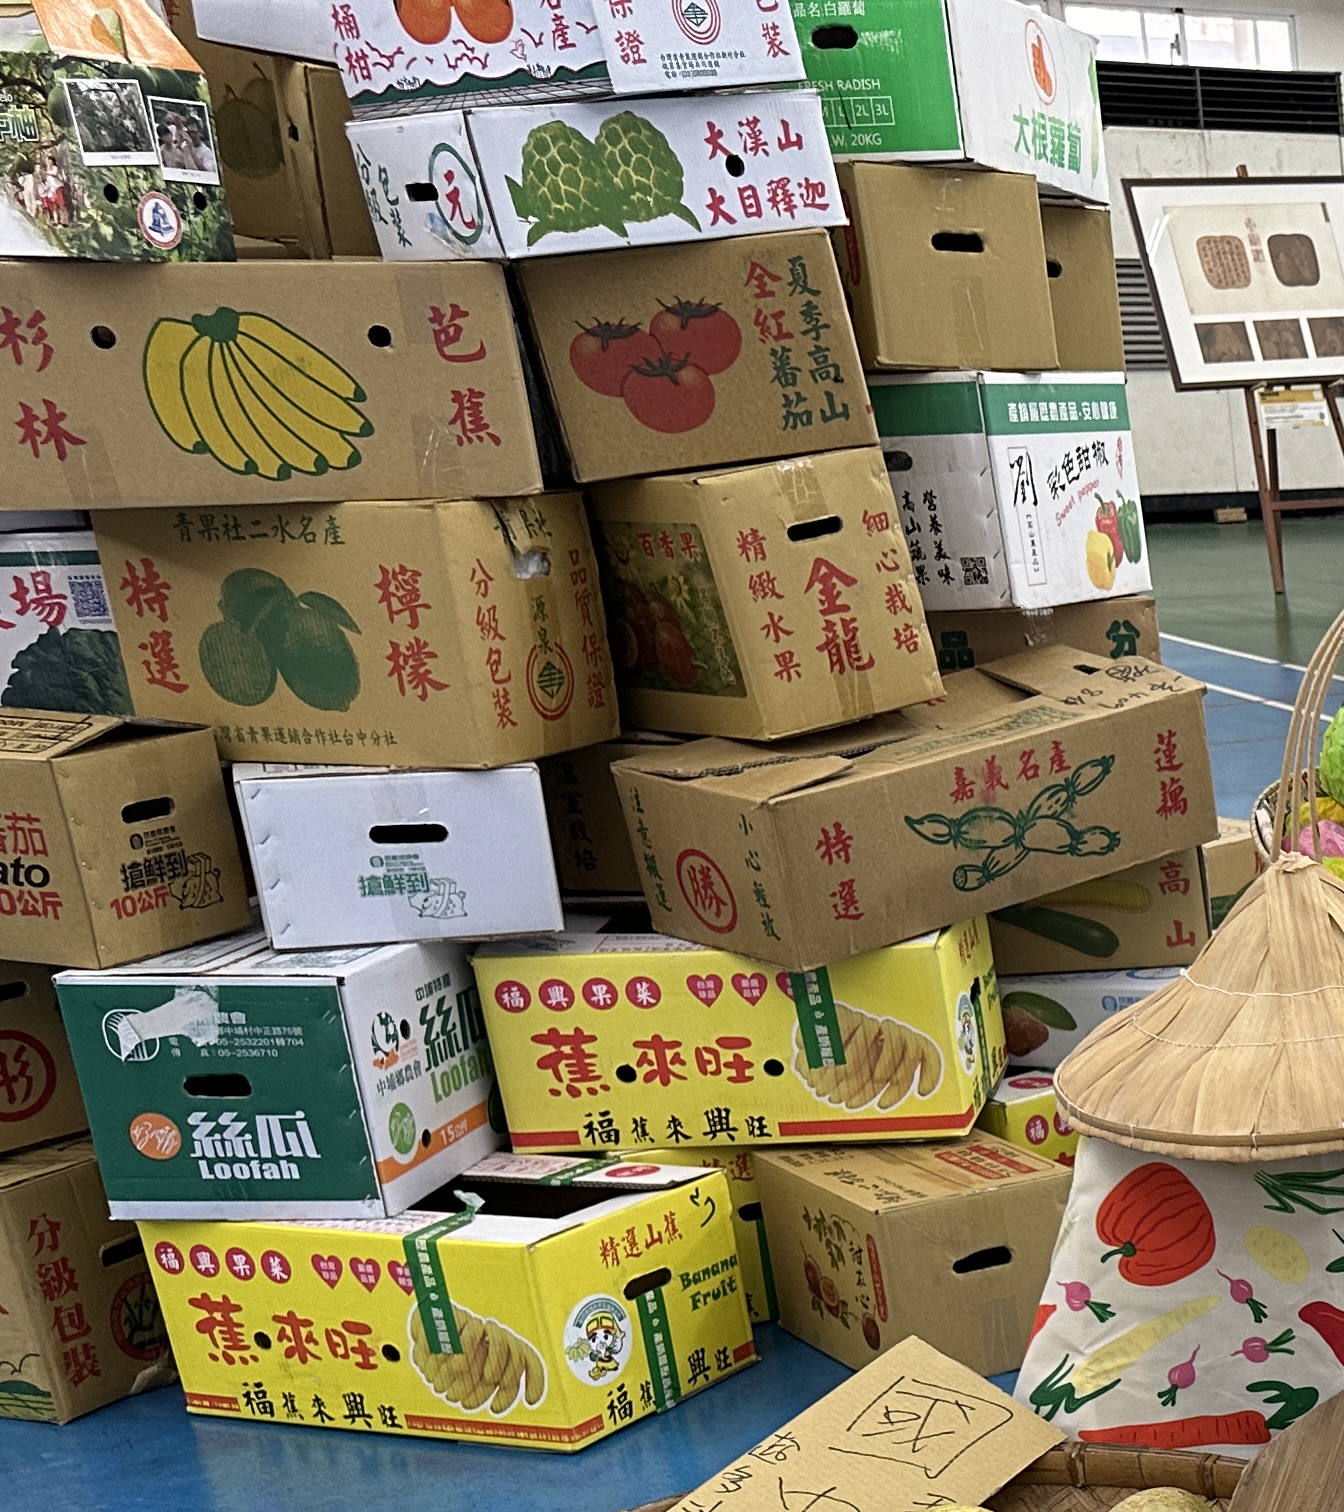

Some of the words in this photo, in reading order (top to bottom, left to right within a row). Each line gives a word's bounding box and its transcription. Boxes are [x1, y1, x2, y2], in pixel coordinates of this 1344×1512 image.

[331, 3, 373, 84] 桶柑
[836, 79, 881, 91] RADISH
[855, 104, 870, 117] 2L
[875, 104, 889, 117] 3L
[705, 115, 803, 159] 大漢山
[851, 133, 882, 147] 20KG
[1012, 110, 1082, 174] 大根蘿蔔
[705, 176, 830, 227] 大目釋迦
[743, 260, 815, 432] 全紅蕃茄
[787, 254, 850, 424] 夏季高山
[0, 308, 87, 461] 杉林
[428, 302, 501, 449] 芭蕉
[1047, 440, 1110, 501] 彩色甜椒
[172, 510, 347, 546] 青果社二水名產
[637, 529, 699, 562] 百香果
[901, 489, 931, 587] 高山蔬果
[922, 489, 956, 587] 營養美味
[0, 569, 68, 630] 場
[736, 526, 803, 684] 精緻水果
[862, 508, 921, 655] 細心栽培
[119, 557, 190, 694] 特選
[373, 562, 451, 703] 檸檬
[469, 557, 519, 730] 分級包裝
[532, 594, 554, 655] 源泉
[567, 547, 607, 710] 品質保證
[803, 556, 877, 676] 金龍
[949, 739, 1073, 804] 嘉義名產
[1153, 728, 1190, 821] 蓮藕
[120, 849, 188, 893] 搶鮮到
[357, 872, 431, 898] 搶鮮到
[686, 862, 728, 920] 勝
[815, 820, 865, 921] 特選
[110, 884, 171, 920] 10公斤
[1158, 859, 1196, 950] 高山
[501, 981, 657, 1010] 福興果菜
[530, 1026, 755, 1099] 蕉來旺
[187, 1110, 322, 1159] 絲瓜
[583, 1106, 774, 1147] 福蕉來興旺
[198, 1159, 301, 1181] Loofah
[160, 1247, 289, 1281] 福興果菜
[599, 1210, 684, 1270] 精選山蕉
[26, 1212, 101, 1387] 分級包裝
[678, 1253, 738, 1293] Banana
[689, 1276, 738, 1312] Fruit
[187, 1291, 379, 1371] 蕉來旺
[242, 1381, 404, 1430] 福蕉來興旺
